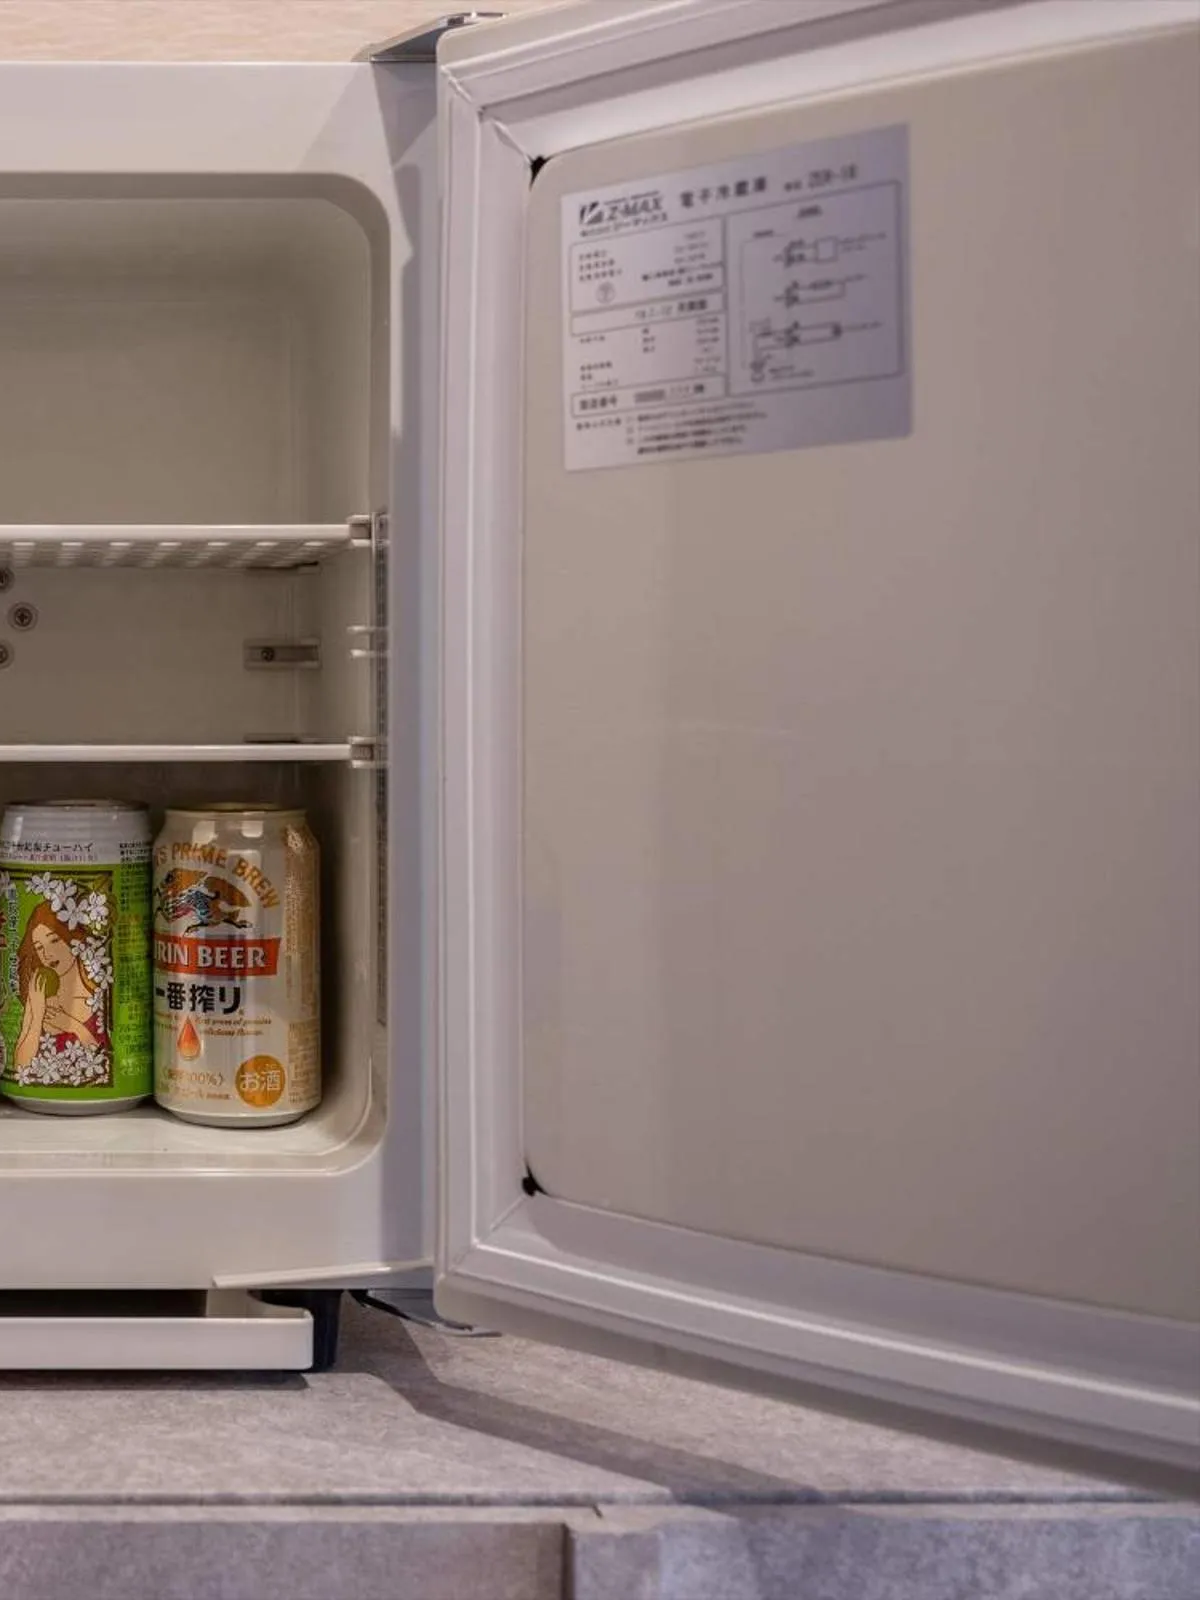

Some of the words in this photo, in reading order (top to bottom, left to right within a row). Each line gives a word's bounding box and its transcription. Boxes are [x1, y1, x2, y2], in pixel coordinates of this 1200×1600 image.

[233, 858, 280, 909] BREW
[154, 939, 189, 966] IRIN
[196, 946, 266, 969] BEER
[155, 981, 241, 1015] 一番搾り
[240, 1070, 281, 1092] お酒
